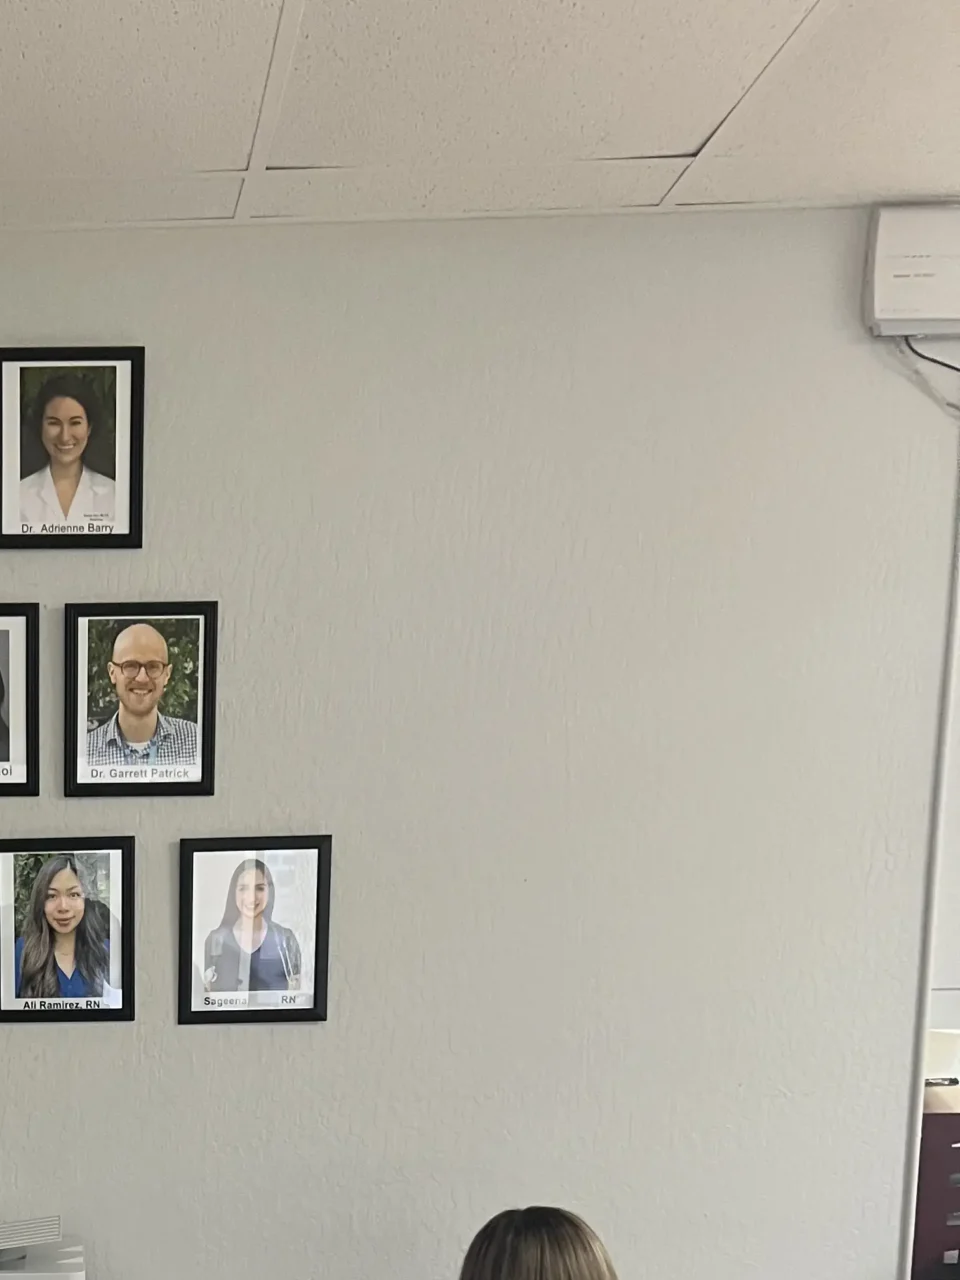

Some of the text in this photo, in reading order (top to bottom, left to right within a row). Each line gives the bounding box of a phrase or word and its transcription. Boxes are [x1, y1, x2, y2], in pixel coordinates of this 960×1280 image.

[21, 522, 114, 535] Dr. Adrienne Barry
[90, 768, 189, 778] Dr. Garrett Patrick
[281, 995, 296, 1004] RN
[23, 1000, 100, 1010] Ali Ramirez, RN
